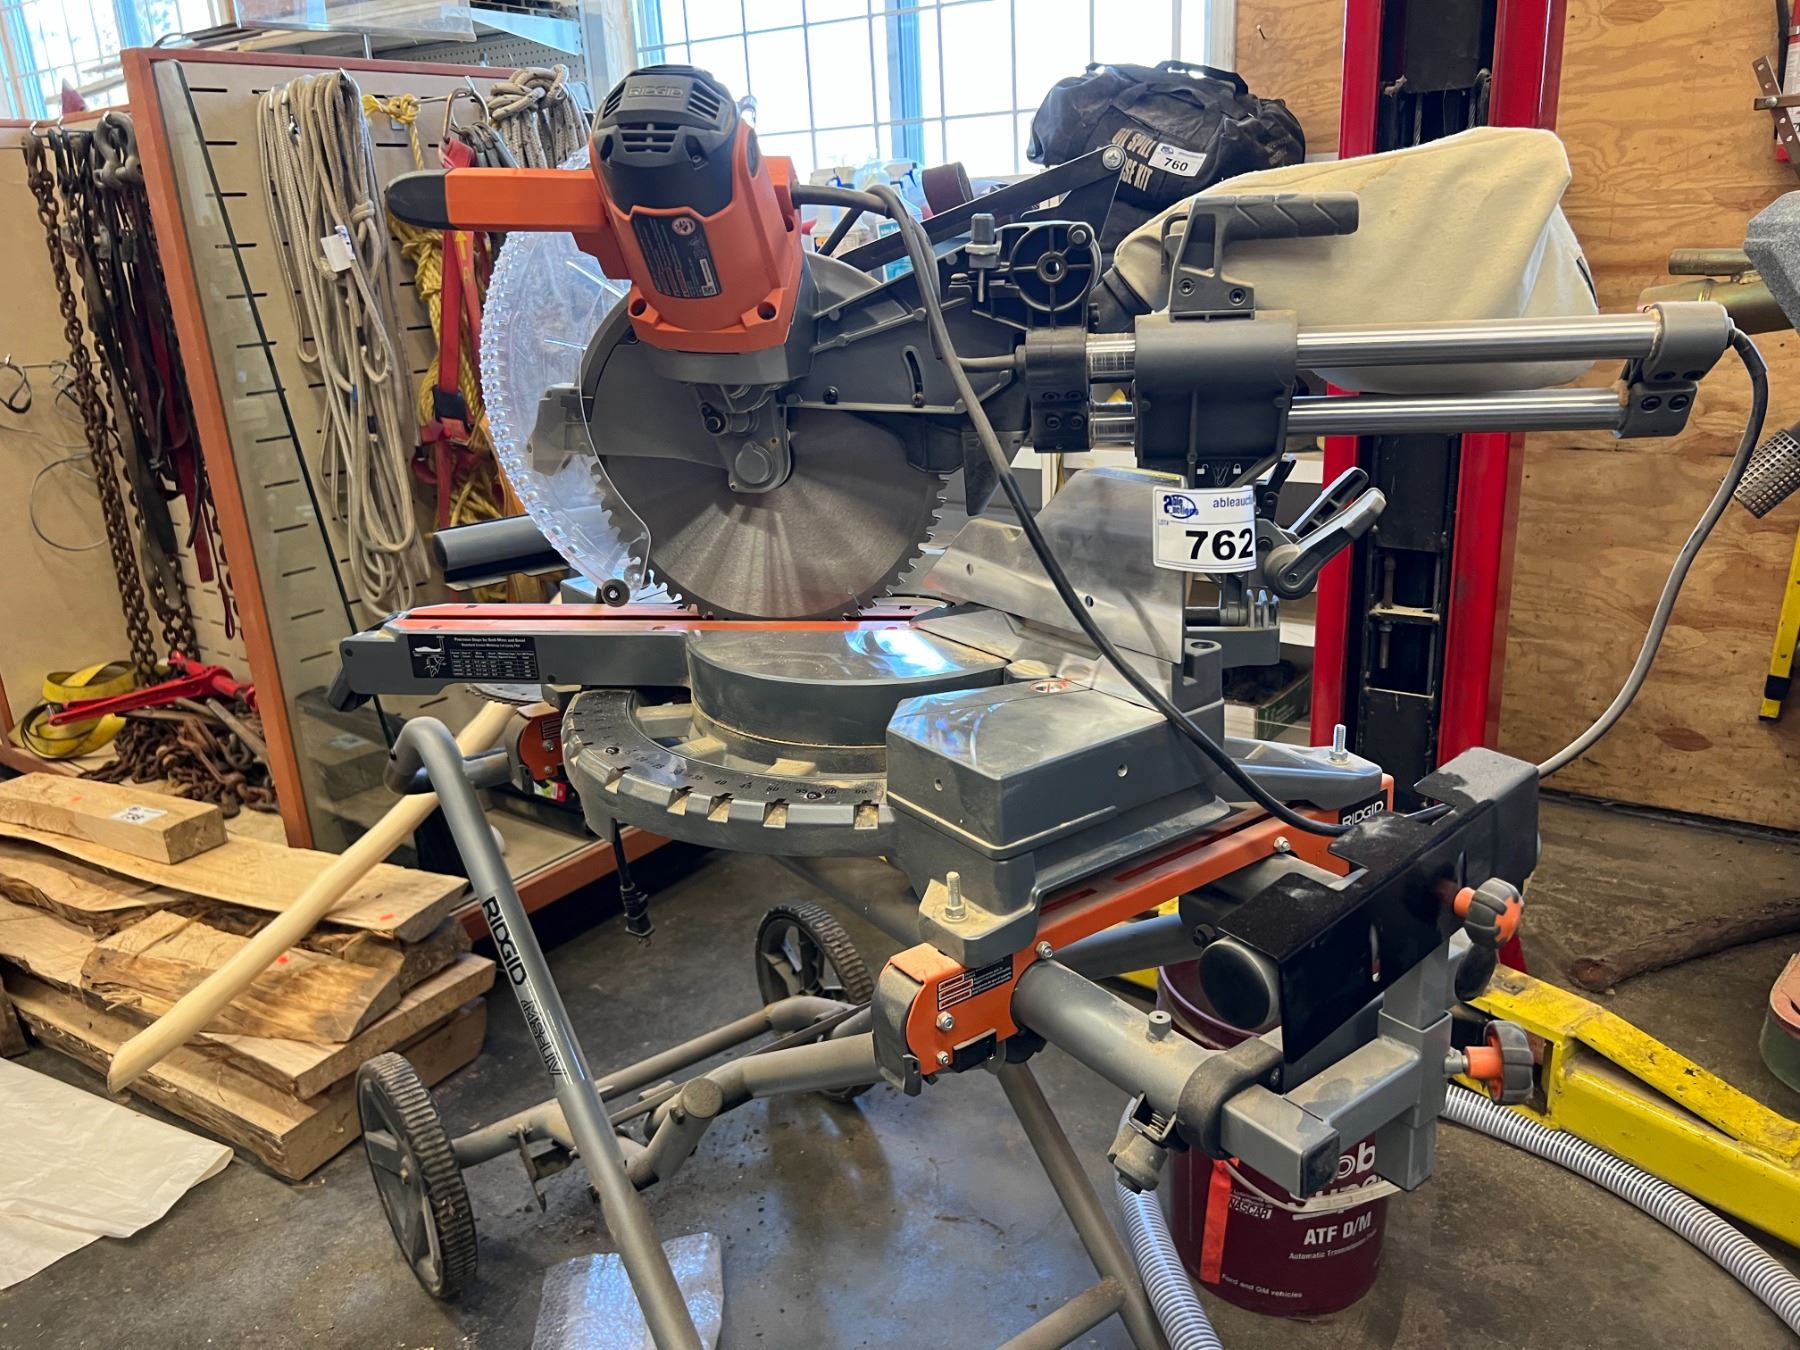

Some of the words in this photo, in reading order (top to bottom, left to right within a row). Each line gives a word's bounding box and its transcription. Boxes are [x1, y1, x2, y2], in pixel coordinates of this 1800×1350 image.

[627, 86, 684, 97] RIDGID
[1126, 133, 1157, 159] SPILL
[1133, 163, 1153, 192] KIT
[1164, 157, 1189, 172] 760
[1185, 528, 1254, 561] 762
[1342, 800, 1384, 826] RIDGID
[482, 896, 527, 986] RIDGID
[1303, 1225, 1338, 1246] ATF
[1342, 1211, 1372, 1239] D/M
[1289, 1252, 1326, 1260] Automatic
[1255, 1286, 1270, 1294] GM
[1271, 1290, 1303, 1298] vehicles
